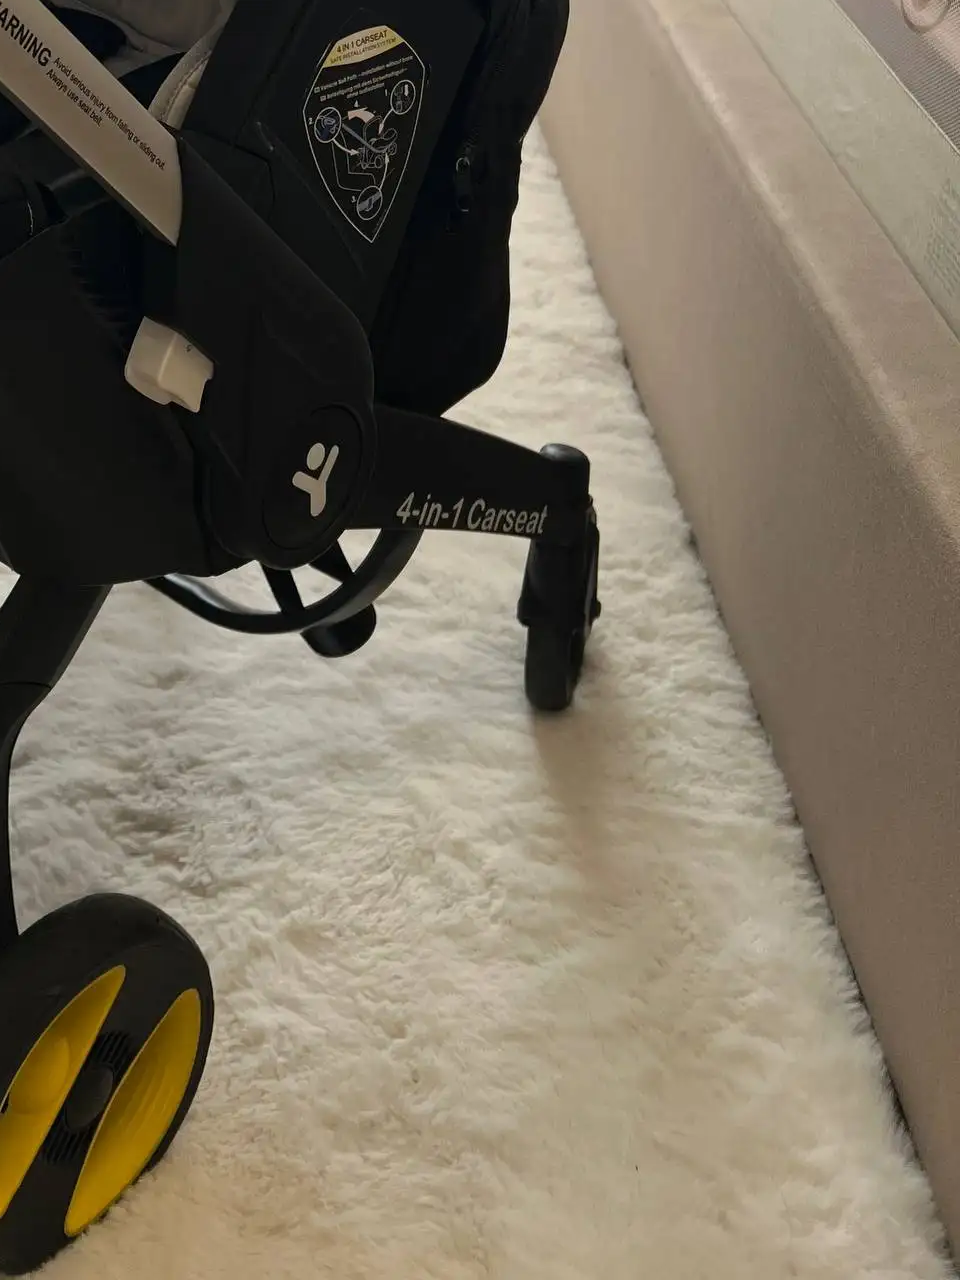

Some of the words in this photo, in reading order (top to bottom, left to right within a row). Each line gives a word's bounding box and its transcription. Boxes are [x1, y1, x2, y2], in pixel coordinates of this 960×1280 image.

[355, 30, 388, 47] CARSEAT
[46, 69, 68, 93] Always
[67, 89, 79, 103] use
[78, 100, 92, 115] seat
[54, 57, 72, 77] Avoid
[70, 74, 91, 97] serious
[90, 93, 106, 112] injury
[105, 106, 119, 125] from
[118, 119, 134, 141] falling
[133, 136, 141, 145] or
[140, 142, 157, 163] sliding
[396, 491, 465, 529] 4-in-1
[467, 498, 548, 534] Carseat
